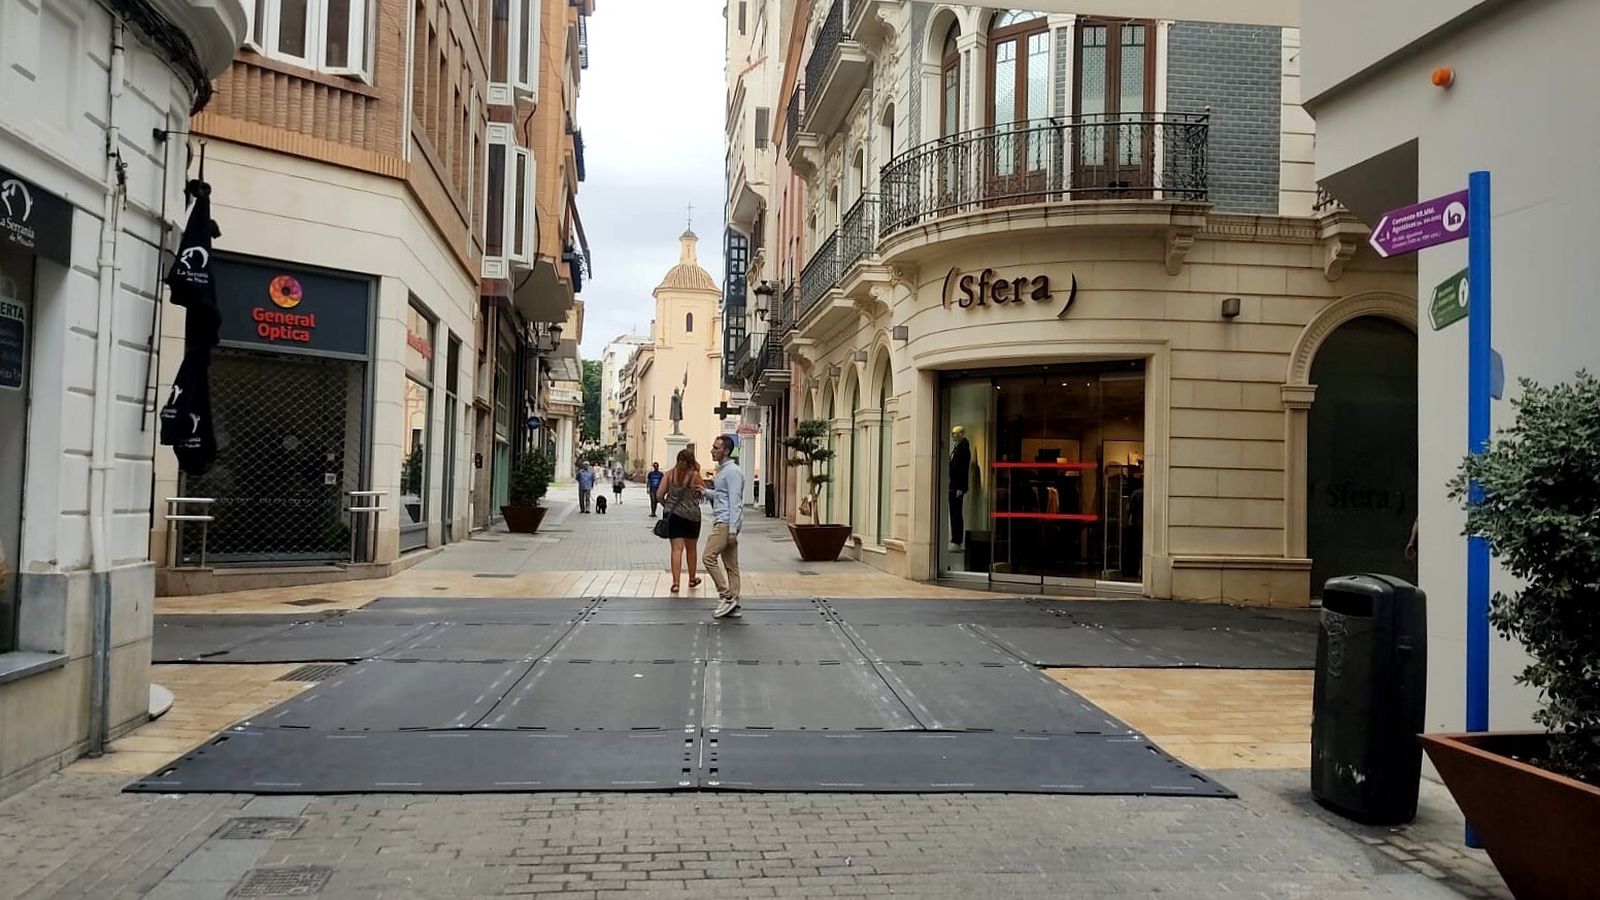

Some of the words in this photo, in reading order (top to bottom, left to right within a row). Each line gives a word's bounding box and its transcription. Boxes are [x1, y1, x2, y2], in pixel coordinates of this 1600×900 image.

[0, 301, 24, 320] ERTA
[251, 307, 316, 328] General
[257, 322, 310, 342] Optica
